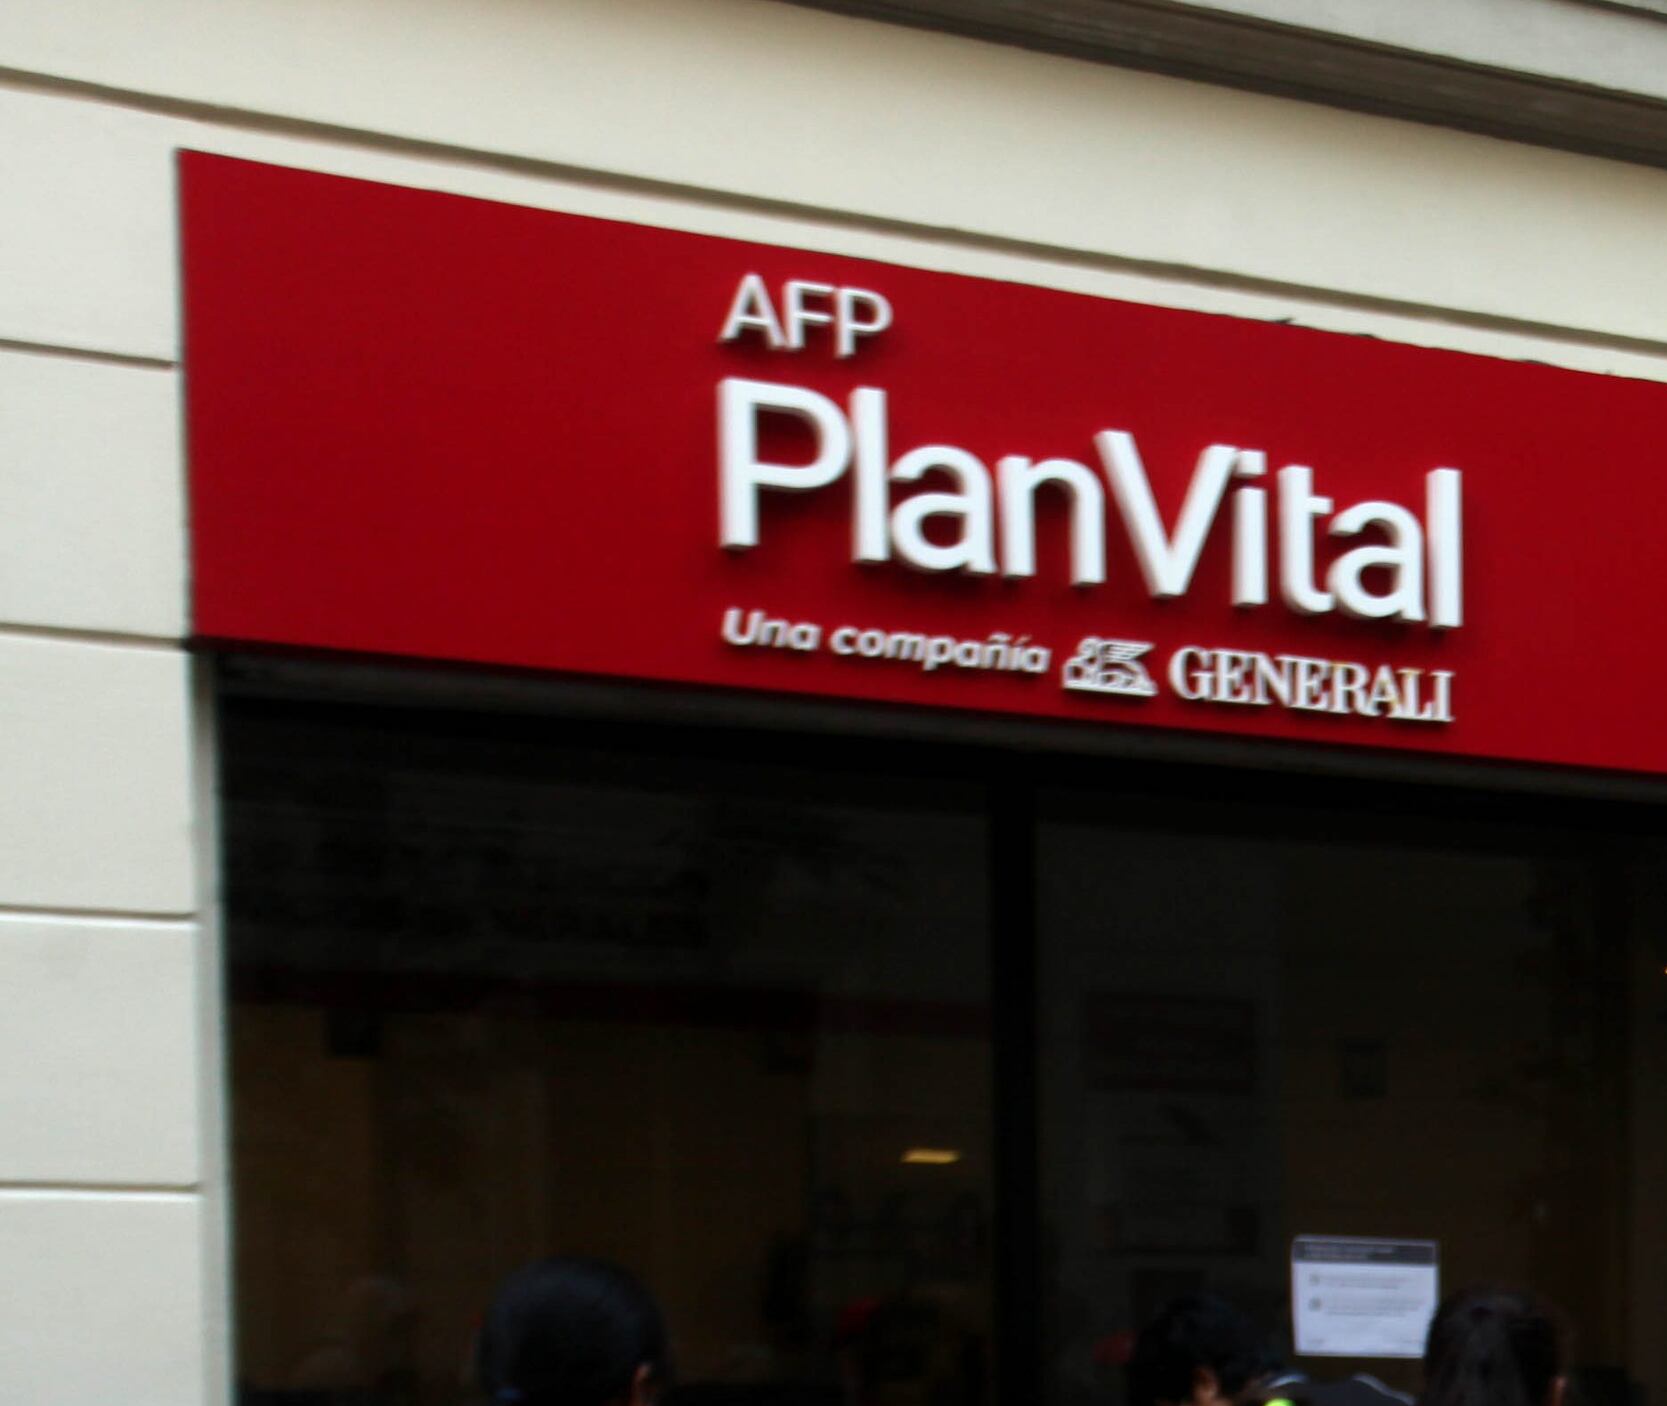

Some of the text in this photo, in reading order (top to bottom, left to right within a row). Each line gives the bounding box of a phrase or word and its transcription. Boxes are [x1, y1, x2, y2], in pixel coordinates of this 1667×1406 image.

[720, 273, 893, 357] AFP
[717, 377, 1463, 628] PlanVital
[722, 608, 1454, 722] Una compañía GENERALI
